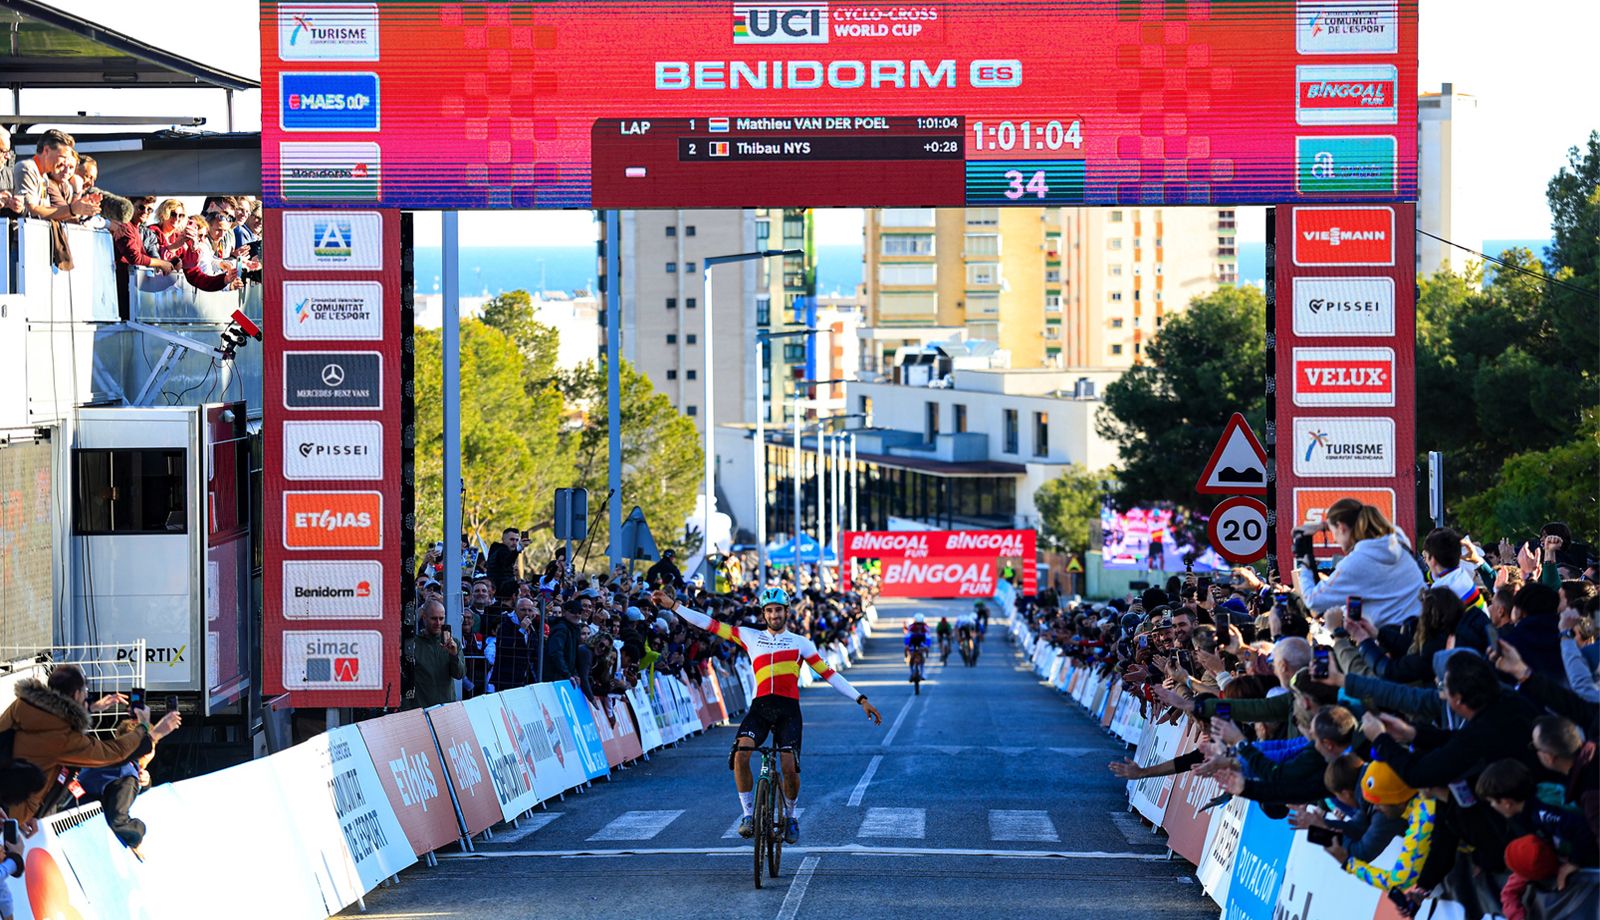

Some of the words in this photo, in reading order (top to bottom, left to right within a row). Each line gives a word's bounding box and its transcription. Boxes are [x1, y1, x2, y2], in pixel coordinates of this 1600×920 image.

[833, 8, 938, 21] CYCLO-CROSS
[749, 9, 820, 37] UCI
[310, 28, 367, 39] TURISME
[833, 24, 889, 37] WORLD
[891, 24, 922, 37] CUP
[1328, 25, 1341, 34] DE
[1343, 25, 1385, 34] L'ESPORT
[655, 60, 957, 90] BENIDORM
[978, 66, 1014, 81] ES
[300, 93, 346, 110] MAES
[621, 121, 651, 134] LAP
[688, 119, 696, 130] 1
[736, 118, 792, 130] Mathieu
[794, 118, 824, 129] VAN
[825, 118, 853, 129] DER
[854, 118, 889, 129] POEL
[916, 118, 958, 128] 1:01:04
[973, 121, 1083, 150] 1:01:04
[688, 143, 697, 155] 2
[737, 143, 781, 154] Thibau
[783, 143, 811, 154] NYS
[923, 142, 958, 152] +0:28
[1004, 170, 1049, 200] 34
[310, 303, 363, 312] COMUNITAT
[1326, 301, 1379, 311] PISSEI
[314, 312, 327, 320] DE
[328, 312, 370, 320] L'ESPORT
[1304, 368, 1383, 386] VELUX
[296, 389, 351, 397] MERCEDES-BENZ
[352, 389, 370, 397] VANS
[316, 445, 367, 455] PISSEI
[1326, 443, 1383, 454] TURISME
[1222, 518, 1262, 542] 20
[904, 549, 929, 558] FUN
[1000, 548, 1024, 557] FUN
[295, 586, 354, 597] Benidorm
[959, 583, 992, 594] FUN
[306, 639, 359, 655] simac
[116, 645, 186, 667] PORTIX
